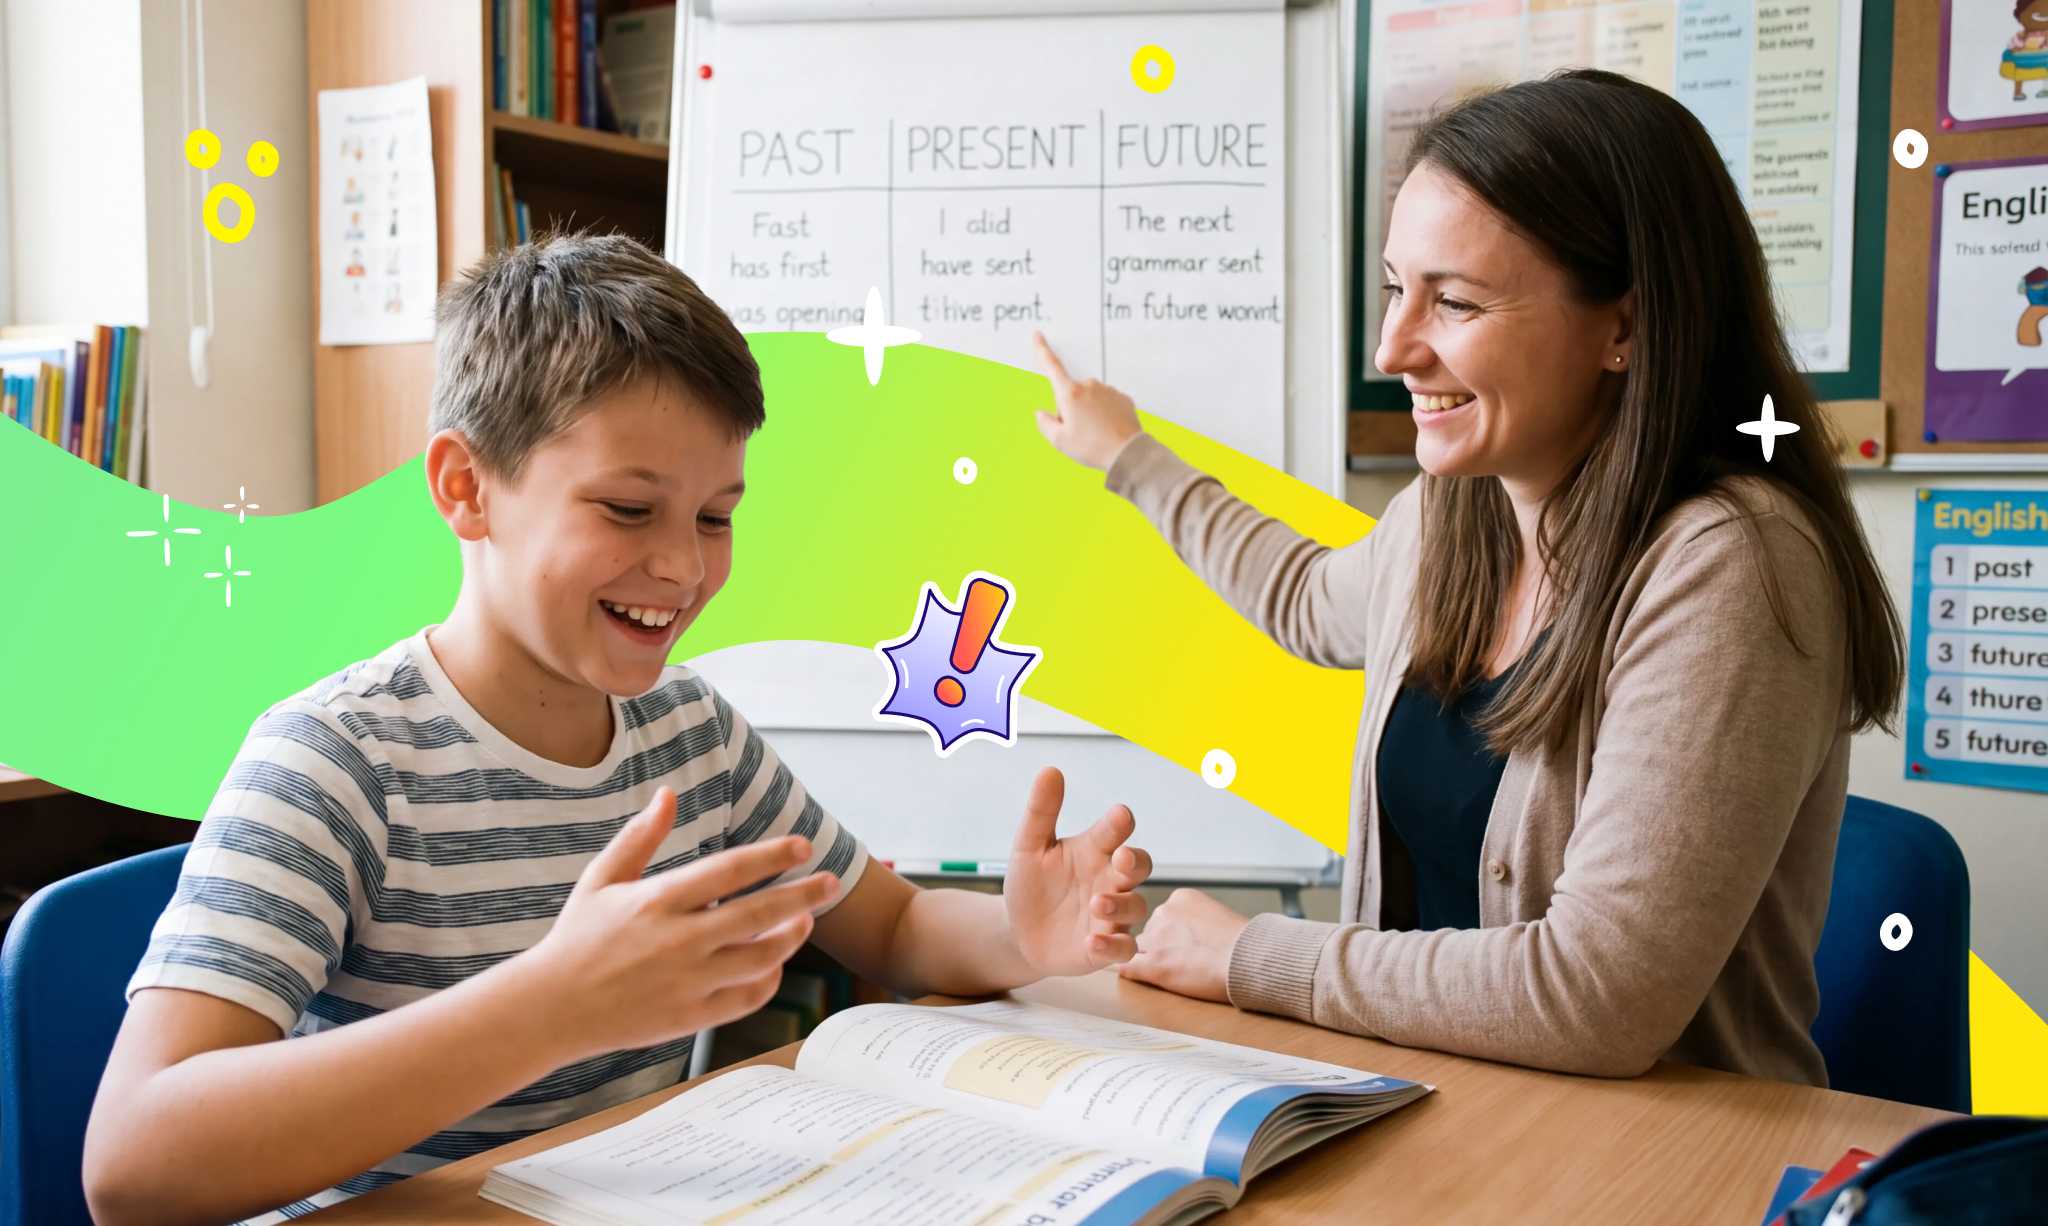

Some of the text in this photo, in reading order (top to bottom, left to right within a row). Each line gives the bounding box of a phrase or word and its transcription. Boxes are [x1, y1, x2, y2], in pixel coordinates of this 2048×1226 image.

[739, 128, 856, 178] PAST
[908, 124, 1086, 173] PRESENT
[1117, 123, 1268, 169] FUTURE
[752, 211, 811, 239] Fast
[1118, 204, 1234, 233] The next
[730, 250, 832, 279] has first
[921, 247, 1035, 277] have sent
[1106, 247, 1263, 285] grammar sent
[1143, 291, 1208, 321] future
[1933, 500, 2048, 537] English
[1945, 556, 2034, 582] 1 past
[1940, 599, 2048, 626] 2 prese
[1937, 642, 2048, 668] 3 future
[1935, 686, 2042, 712] 4 thure
[1934, 729, 2048, 756] 5 future
